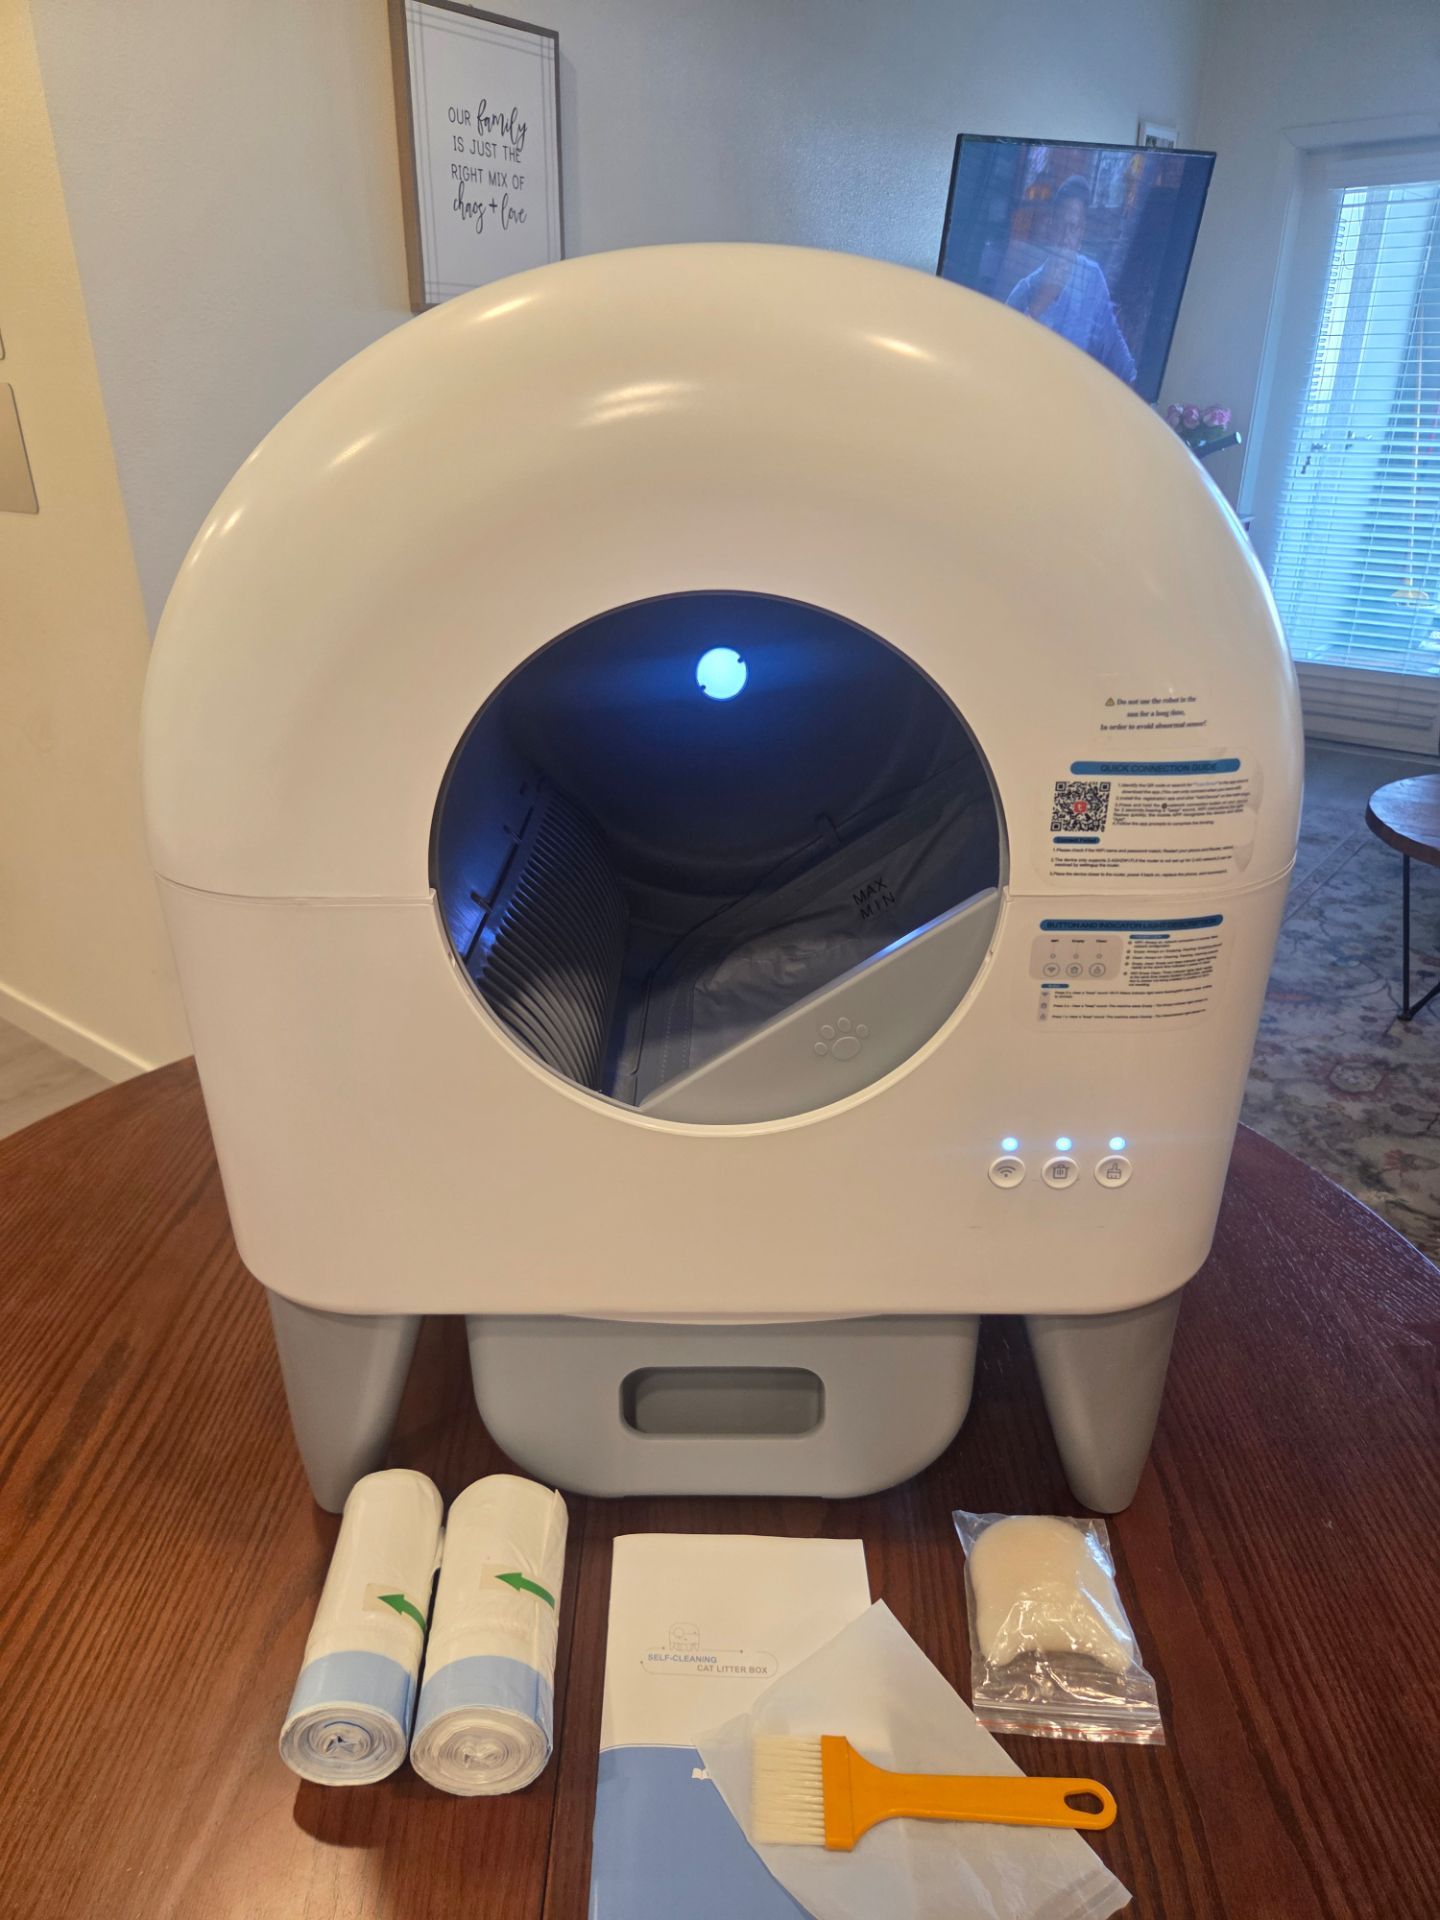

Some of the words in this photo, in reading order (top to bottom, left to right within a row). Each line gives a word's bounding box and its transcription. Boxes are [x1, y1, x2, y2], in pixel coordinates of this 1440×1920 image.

[448, 106, 471, 126] OUR
[477, 99, 527, 151] family
[453, 135, 464, 152] IS
[470, 138, 497, 159] JUST
[502, 145, 521, 163] THE
[451, 163, 483, 184] RIGHT
[489, 171, 508, 188] MIX
[512, 175, 525, 190] OF
[453, 180, 486, 234] chaos
[501, 193, 527, 230] love
[1155, 721, 1185, 729] abnormal
[1101, 764, 1129, 773] QUICK
[1131, 764, 1190, 773] CONNECTION
[1191, 763, 1217, 772] GUIDE
[852, 877, 888, 905] MAX
[860, 891, 895, 920] MIN
[1046, 922, 1079, 930] BUTTON
[1080, 922, 1098, 930] AND
[1099, 922, 1144, 930] INDICATOR
[648, 1653, 717, 1664] SELF-CLEANING
[697, 1664, 714, 1673] CAT
[716, 1665, 747, 1674] LITTER
[749, 1665, 768, 1674] BOX
